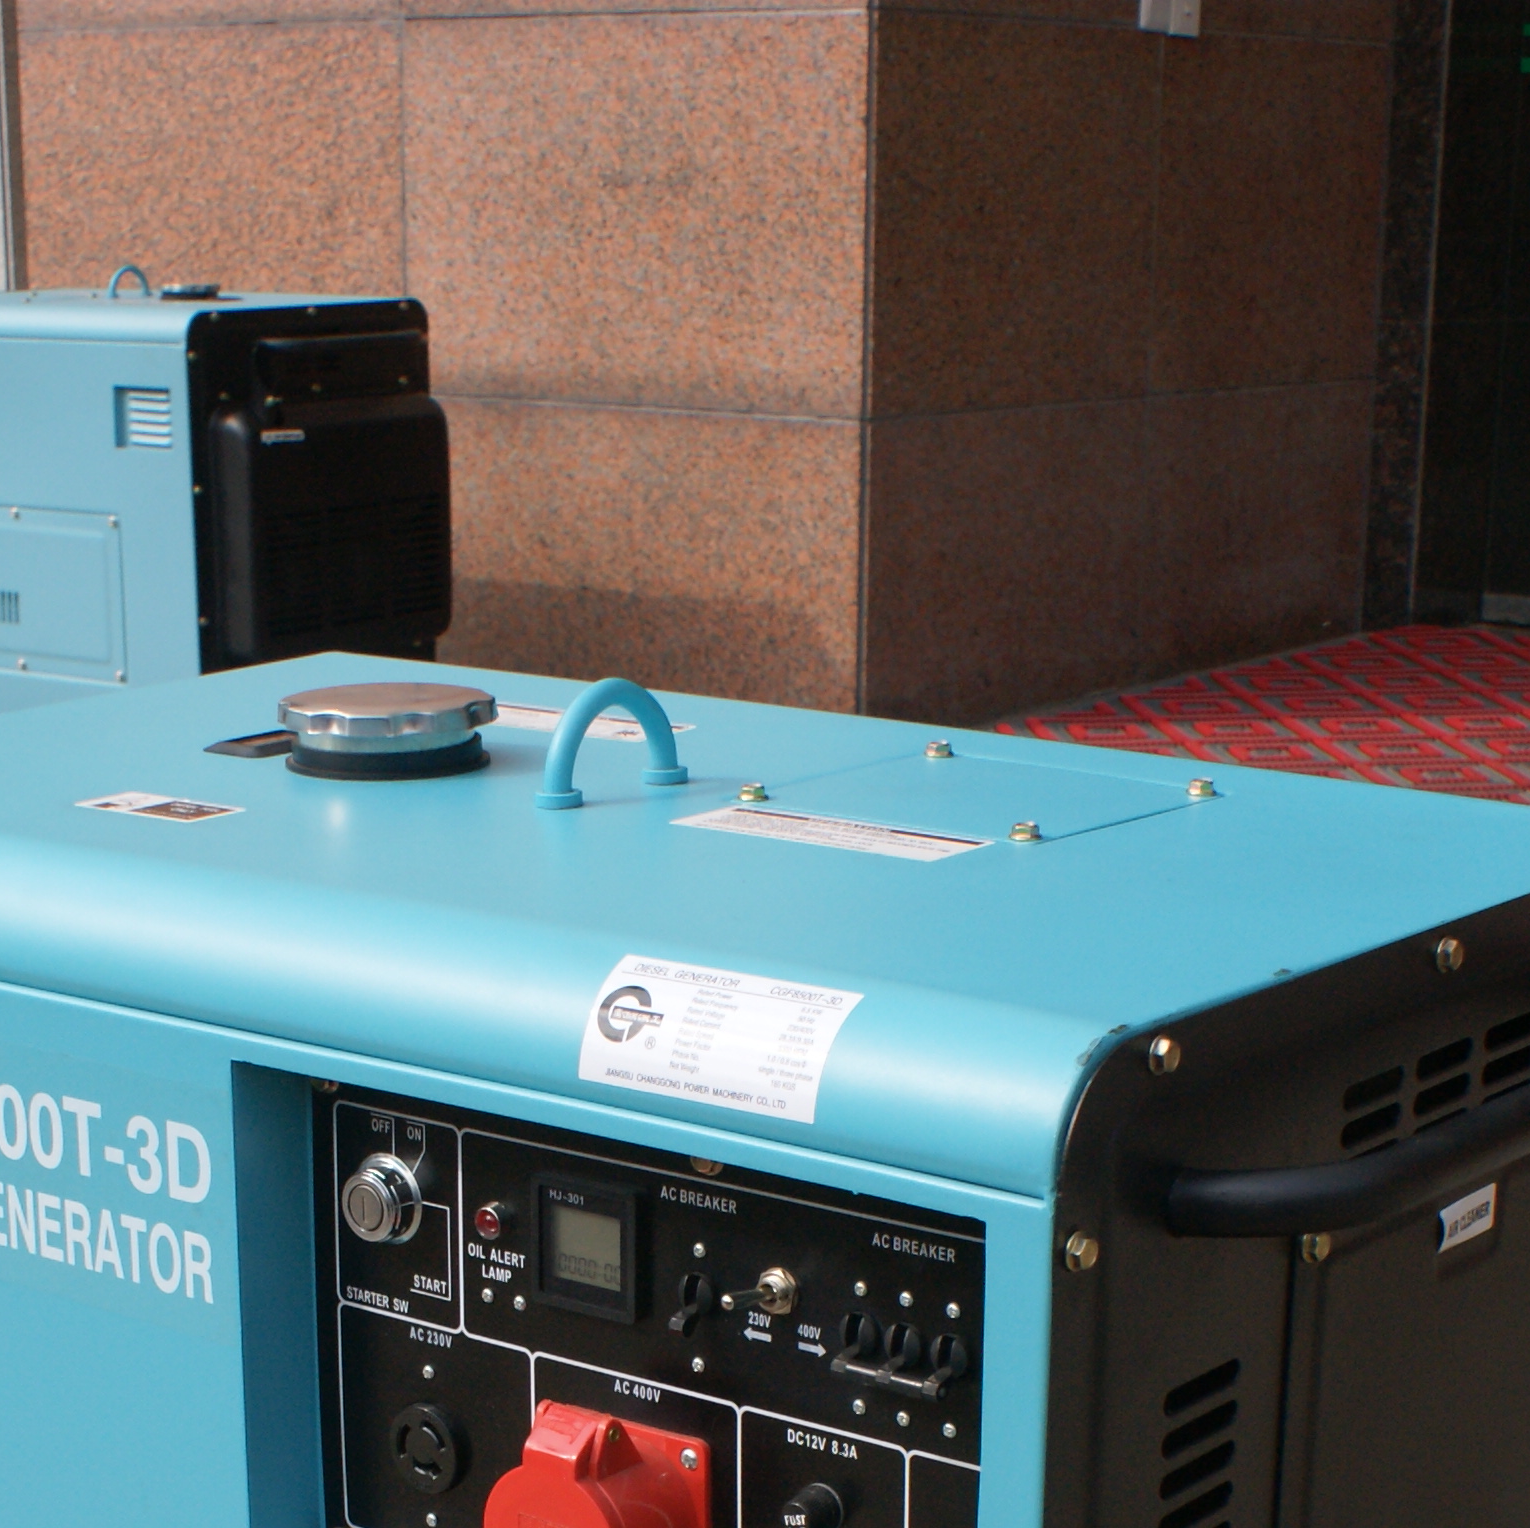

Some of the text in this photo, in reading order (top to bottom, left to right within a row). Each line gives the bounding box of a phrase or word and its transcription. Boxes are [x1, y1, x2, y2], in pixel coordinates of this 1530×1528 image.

[634, 963, 670, 977] DIESEL
[674, 970, 740, 988] GENERATOR
[683, 1081, 710, 1095] POWER
[712, 1088, 753, 1104] MACHINERY
[371, 1118, 391, 1134] OFF
[406, 1126, 422, 1141] ON
[549, 1189, 585, 1206] HJ-301
[660, 1185, 737, 1214] AC BREAKER
[467, 1242, 526, 1269] OIL ALERT
[872, 1232, 956, 1263] AC BREAKER
[413, 1274, 447, 1295] START
[482, 1264, 512, 1283] LAMP
[346, 1285, 409, 1314] STARTER SW
[748, 1311, 771, 1328] 230V
[409, 1326, 452, 1348] AC 230V
[797, 1323, 821, 1340] 400V
[613, 1379, 661, 1403] AC 400V
[787, 1428, 858, 1460] DC12V 8.3A
